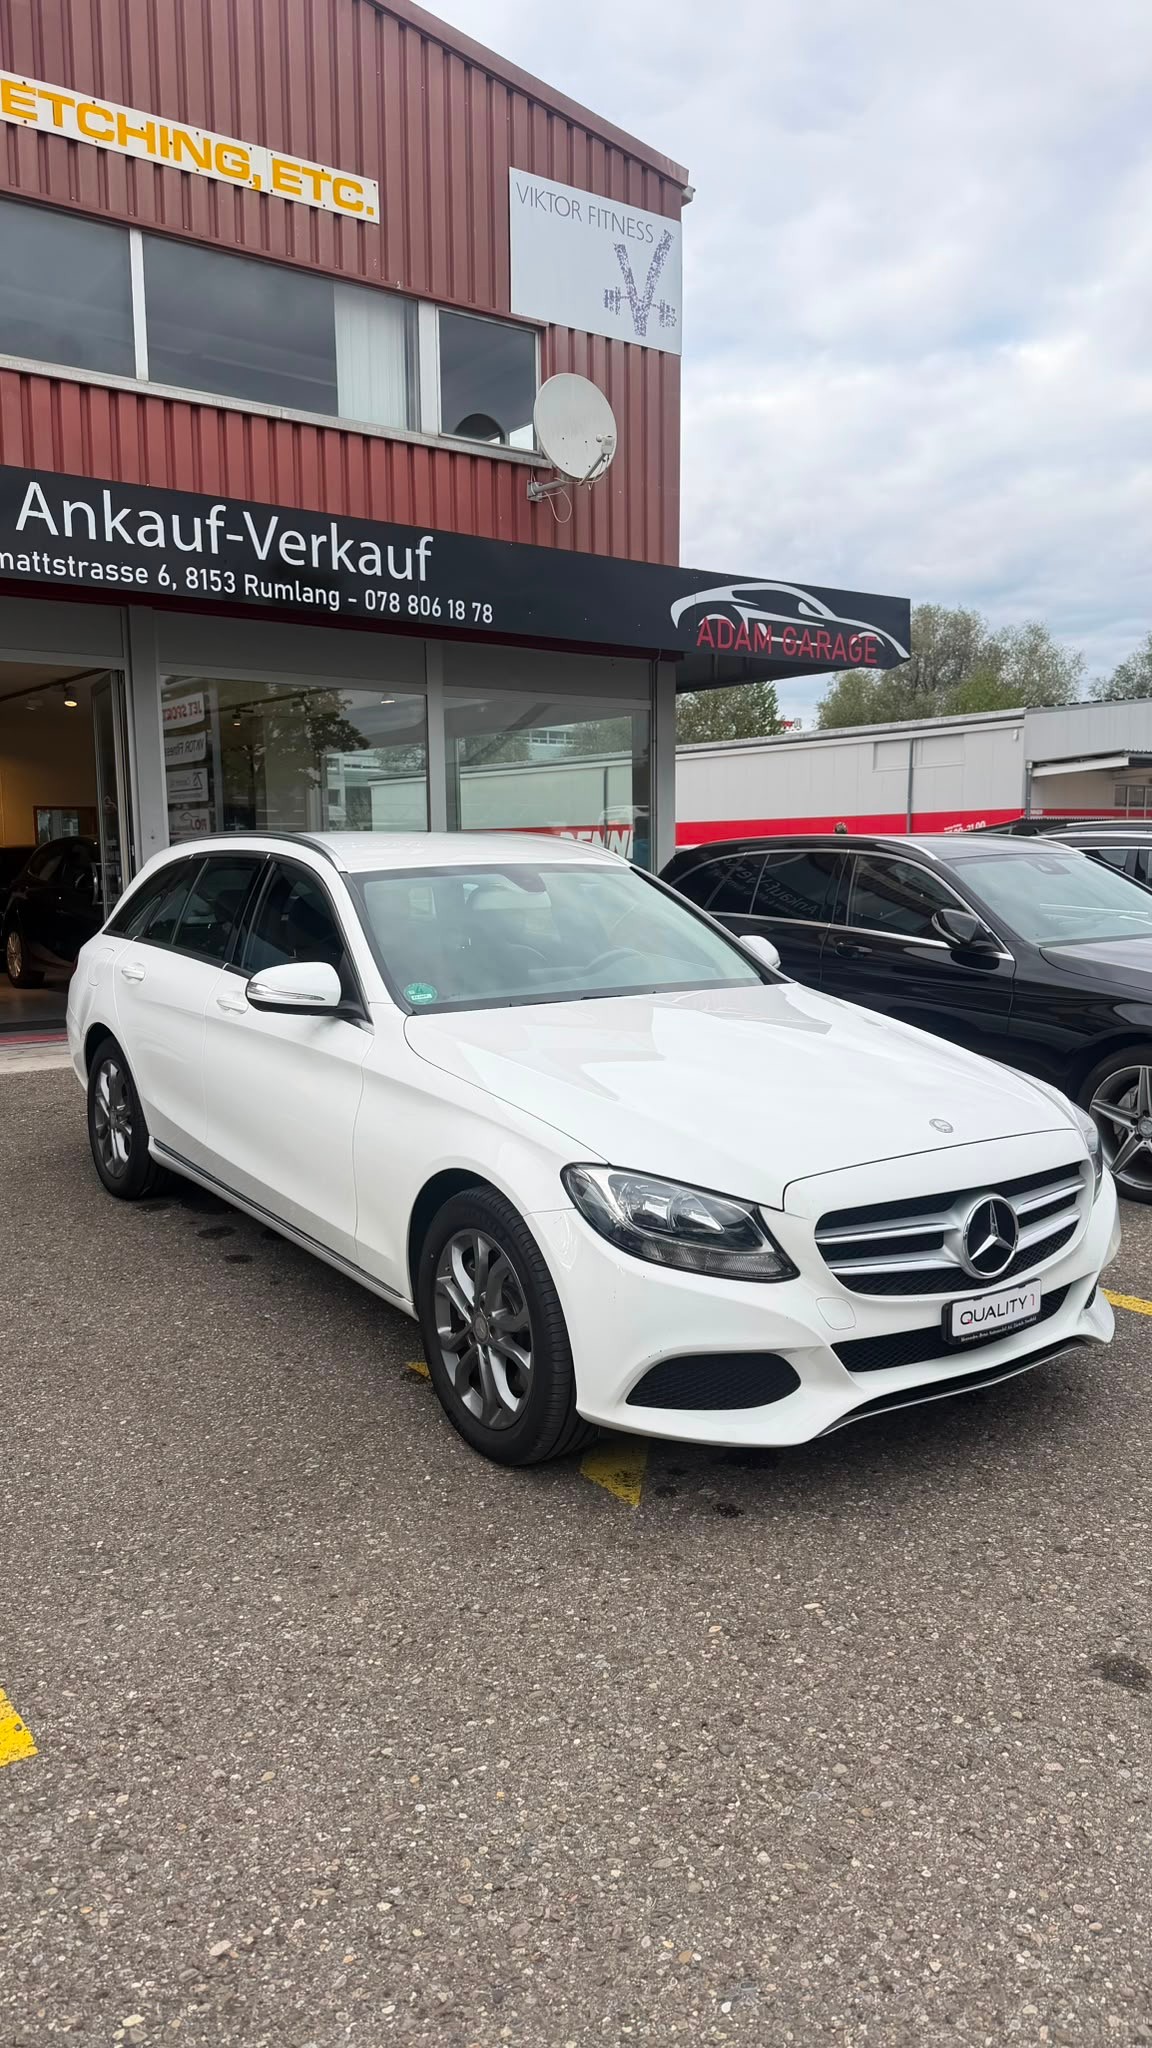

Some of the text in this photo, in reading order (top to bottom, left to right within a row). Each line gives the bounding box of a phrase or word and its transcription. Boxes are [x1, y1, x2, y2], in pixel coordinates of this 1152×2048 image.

[1, 79, 374, 216] ETCHING, ETC.
[516, 182, 654, 244] VIKTOR FITNESS
[15, 481, 434, 582] Ankauf-Verkauf
[158, 564, 177, 591] 6,
[186, 567, 236, 594] 8153
[244, 574, 340, 611] Rumlang
[365, 589, 400, 613] 078
[408, 595, 442, 617] 806
[447, 600, 466, 620] 18
[471, 602, 493, 624] 78
[696, 617, 878, 665] ADAM GARAGE
